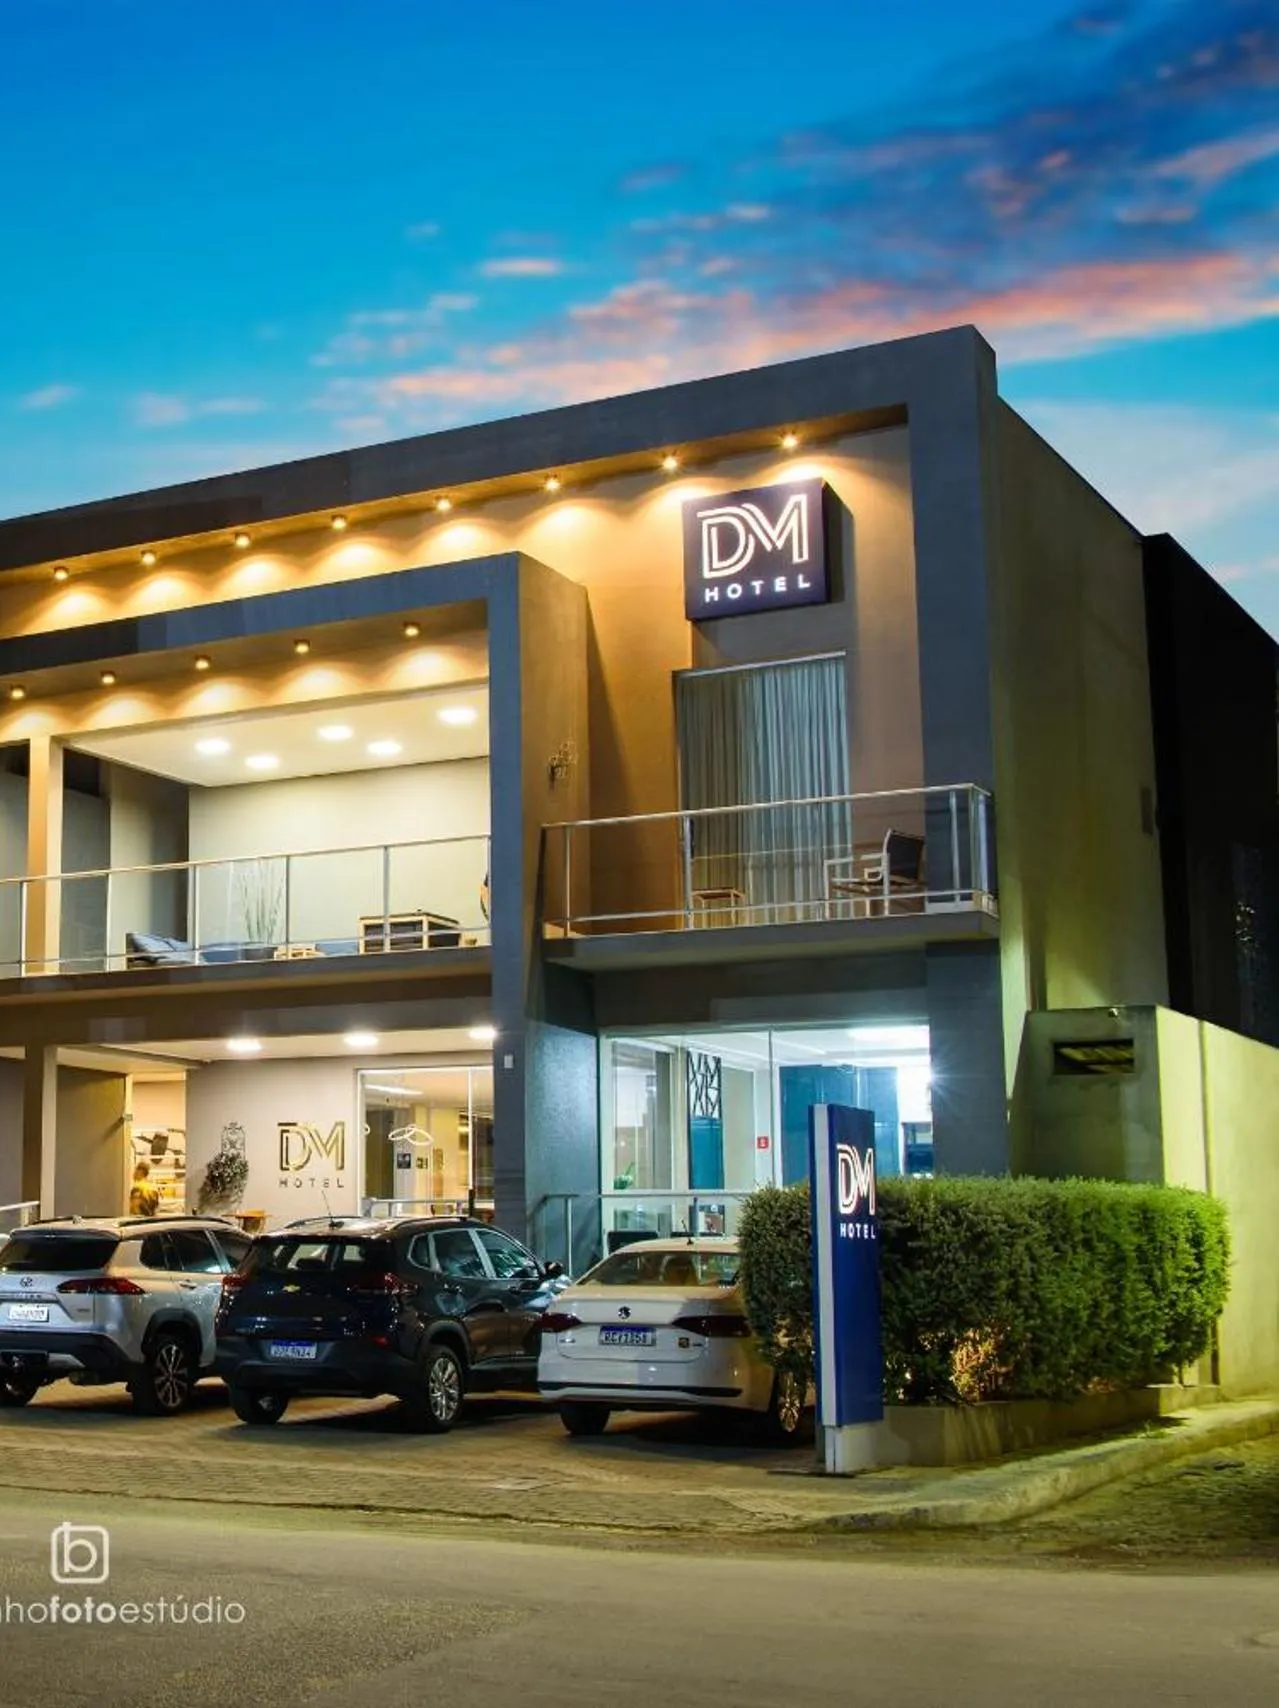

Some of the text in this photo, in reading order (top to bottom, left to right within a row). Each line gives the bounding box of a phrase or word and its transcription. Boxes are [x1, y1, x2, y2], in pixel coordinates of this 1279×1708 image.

[696, 493, 809, 580] DM
[704, 574, 811, 603] HOTEL
[277, 1121, 345, 1171] DM
[279, 1178, 344, 1188] HOTEL
[836, 1143, 875, 1215] DM
[840, 1223, 876, 1239] HOTEL
